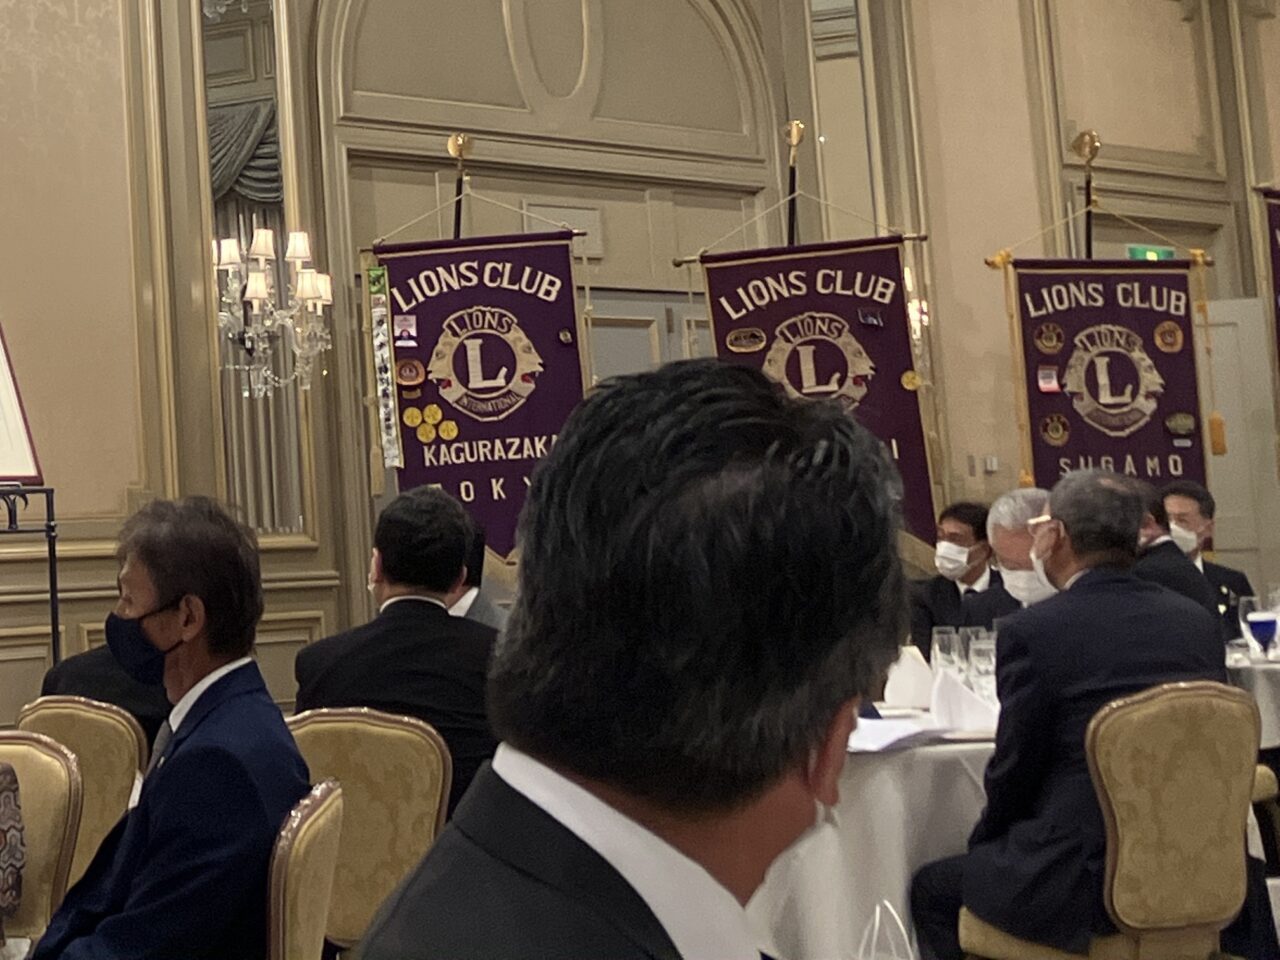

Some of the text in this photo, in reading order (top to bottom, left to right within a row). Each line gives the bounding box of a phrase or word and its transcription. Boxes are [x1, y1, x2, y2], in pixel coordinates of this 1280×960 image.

[391, 261, 562, 312] LIONS CLUB
[719, 269, 896, 320] LIONS CLUB
[1024, 281, 1187, 318] LIONS CLUB
[450, 311, 512, 336] LIONS
[780, 316, 846, 343] LIONS
[463, 338, 508, 389] L
[796, 344, 841, 394] L
[1094, 356, 1133, 404] L
[1059, 454, 1184, 477] SUGAMO
